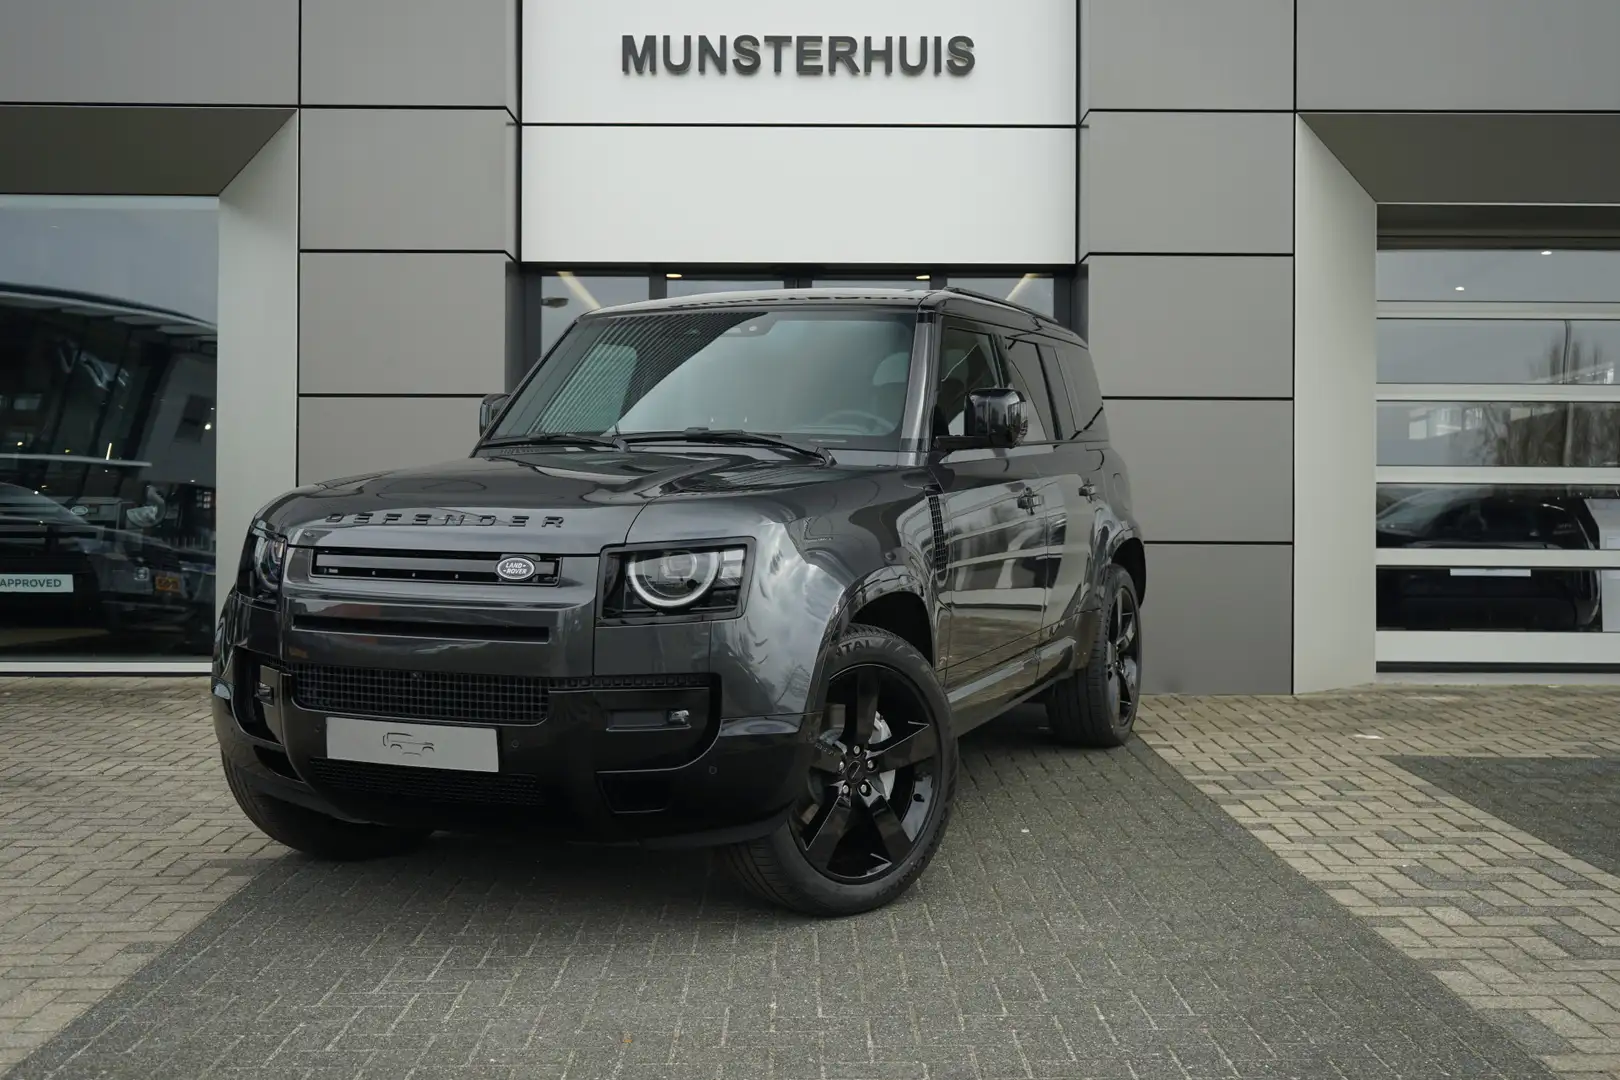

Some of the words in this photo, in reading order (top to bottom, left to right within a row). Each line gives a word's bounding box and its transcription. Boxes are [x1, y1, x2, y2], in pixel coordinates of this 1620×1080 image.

[622, 35, 976, 75] MUNSTERHUIS
[325, 513, 565, 528] DEFENDER
[0, 578, 62, 588] APPROVED
